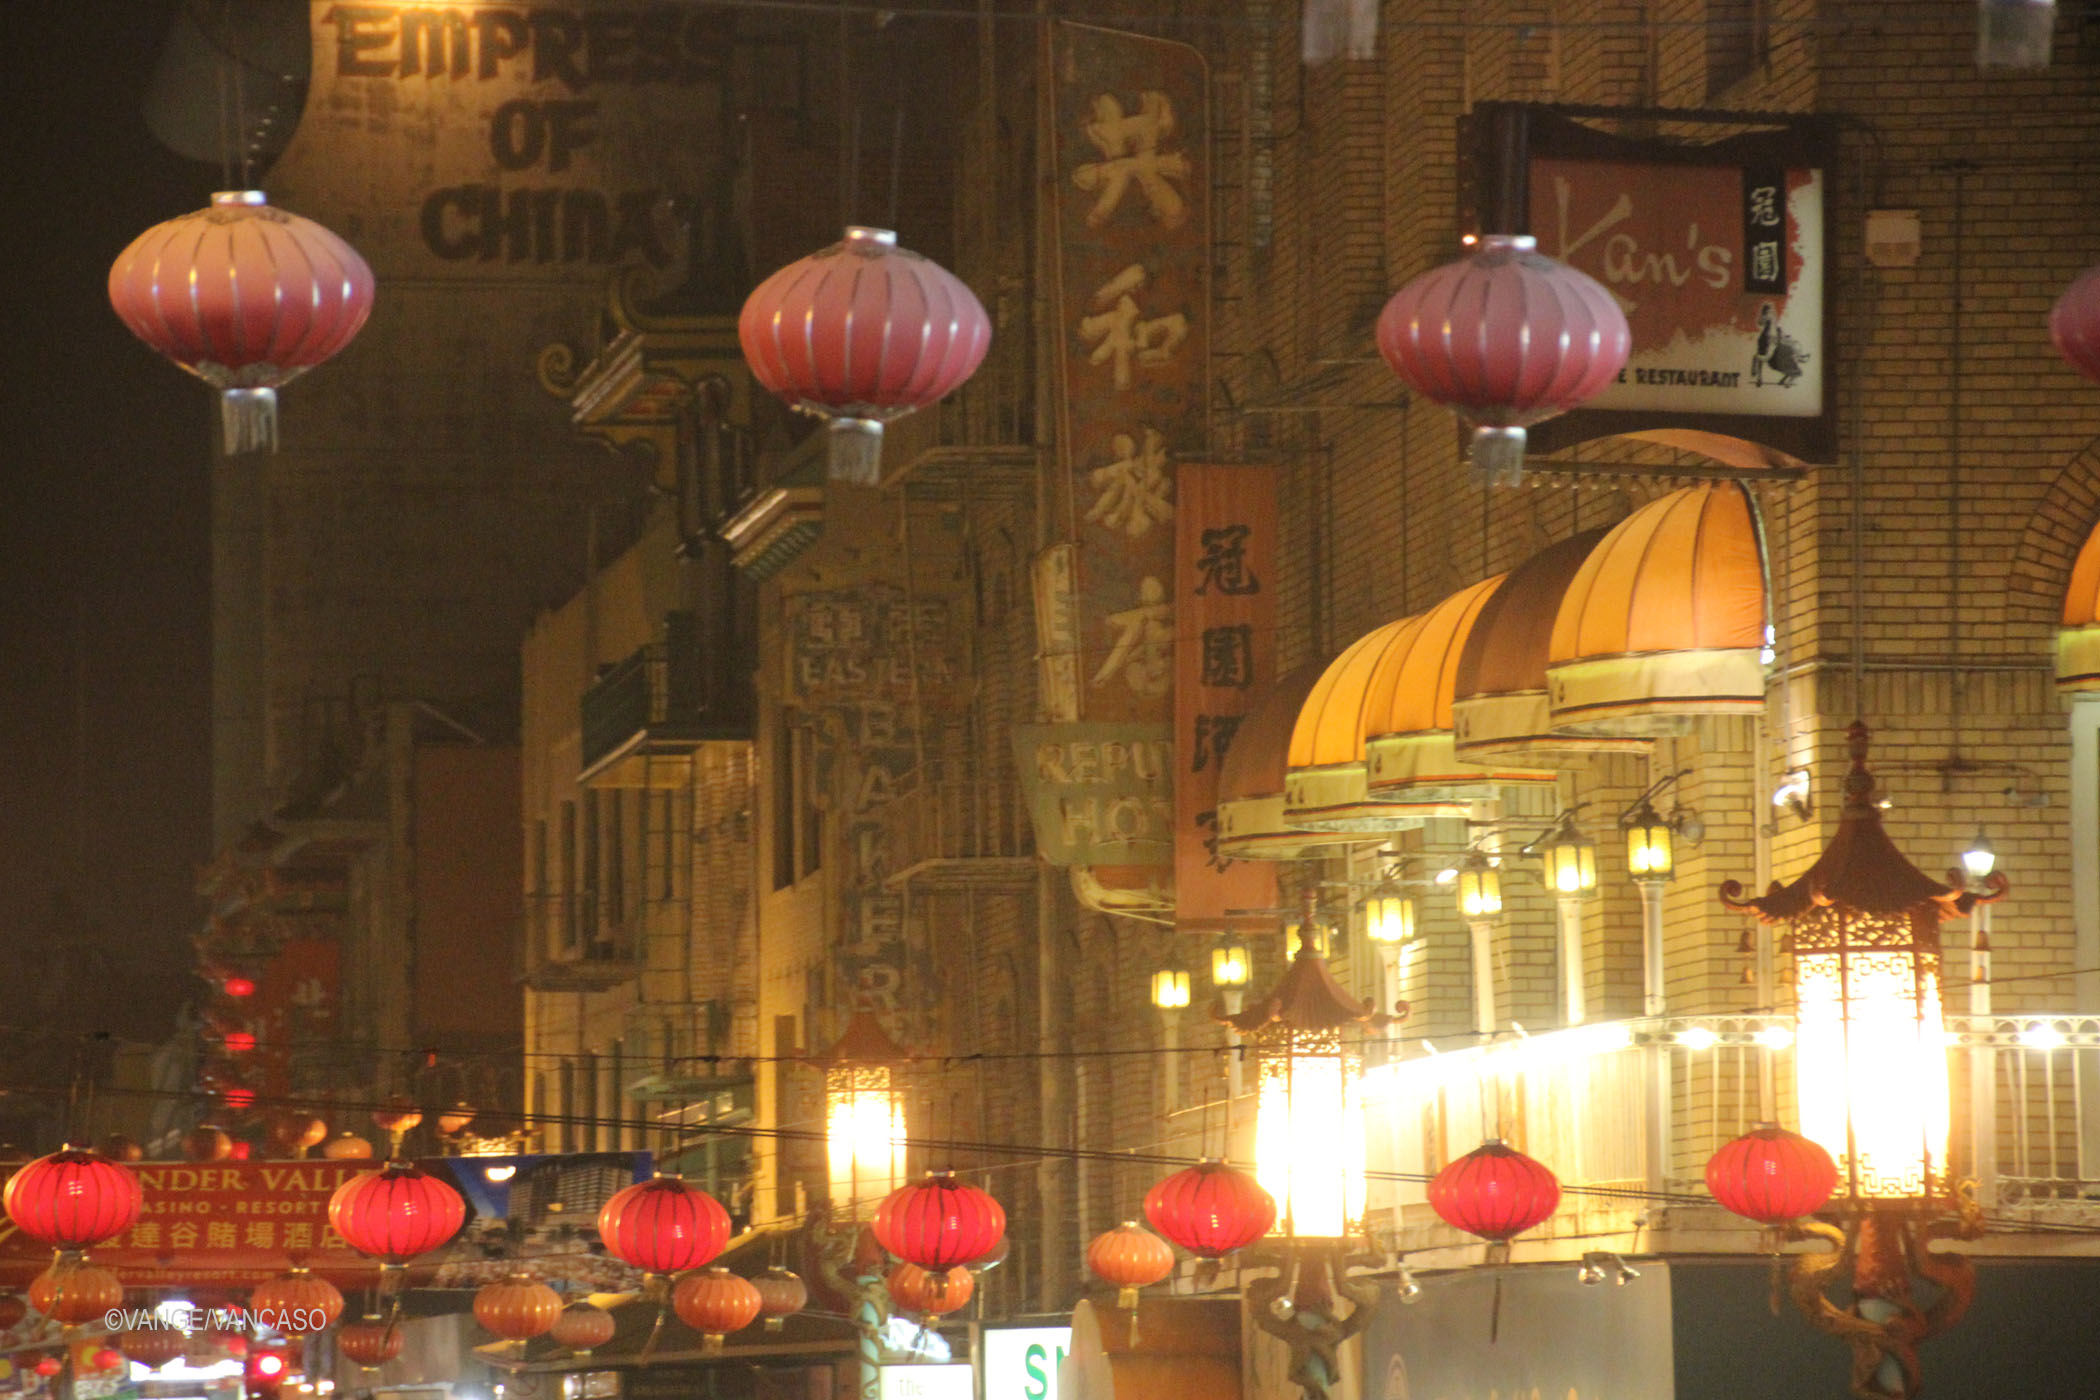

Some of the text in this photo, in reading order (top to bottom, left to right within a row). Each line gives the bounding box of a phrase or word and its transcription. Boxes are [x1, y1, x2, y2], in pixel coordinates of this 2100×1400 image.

[490, 99, 599, 172] OF
[420, 184, 680, 269] CHINA
[1553, 176, 1733, 314] Kan's
[1635, 368, 1742, 388] RESTAURANT
[1037, 741, 1173, 784] REPU
[261, 1169, 378, 1192] VALL
[236, 1201, 320, 1214] RESORT
